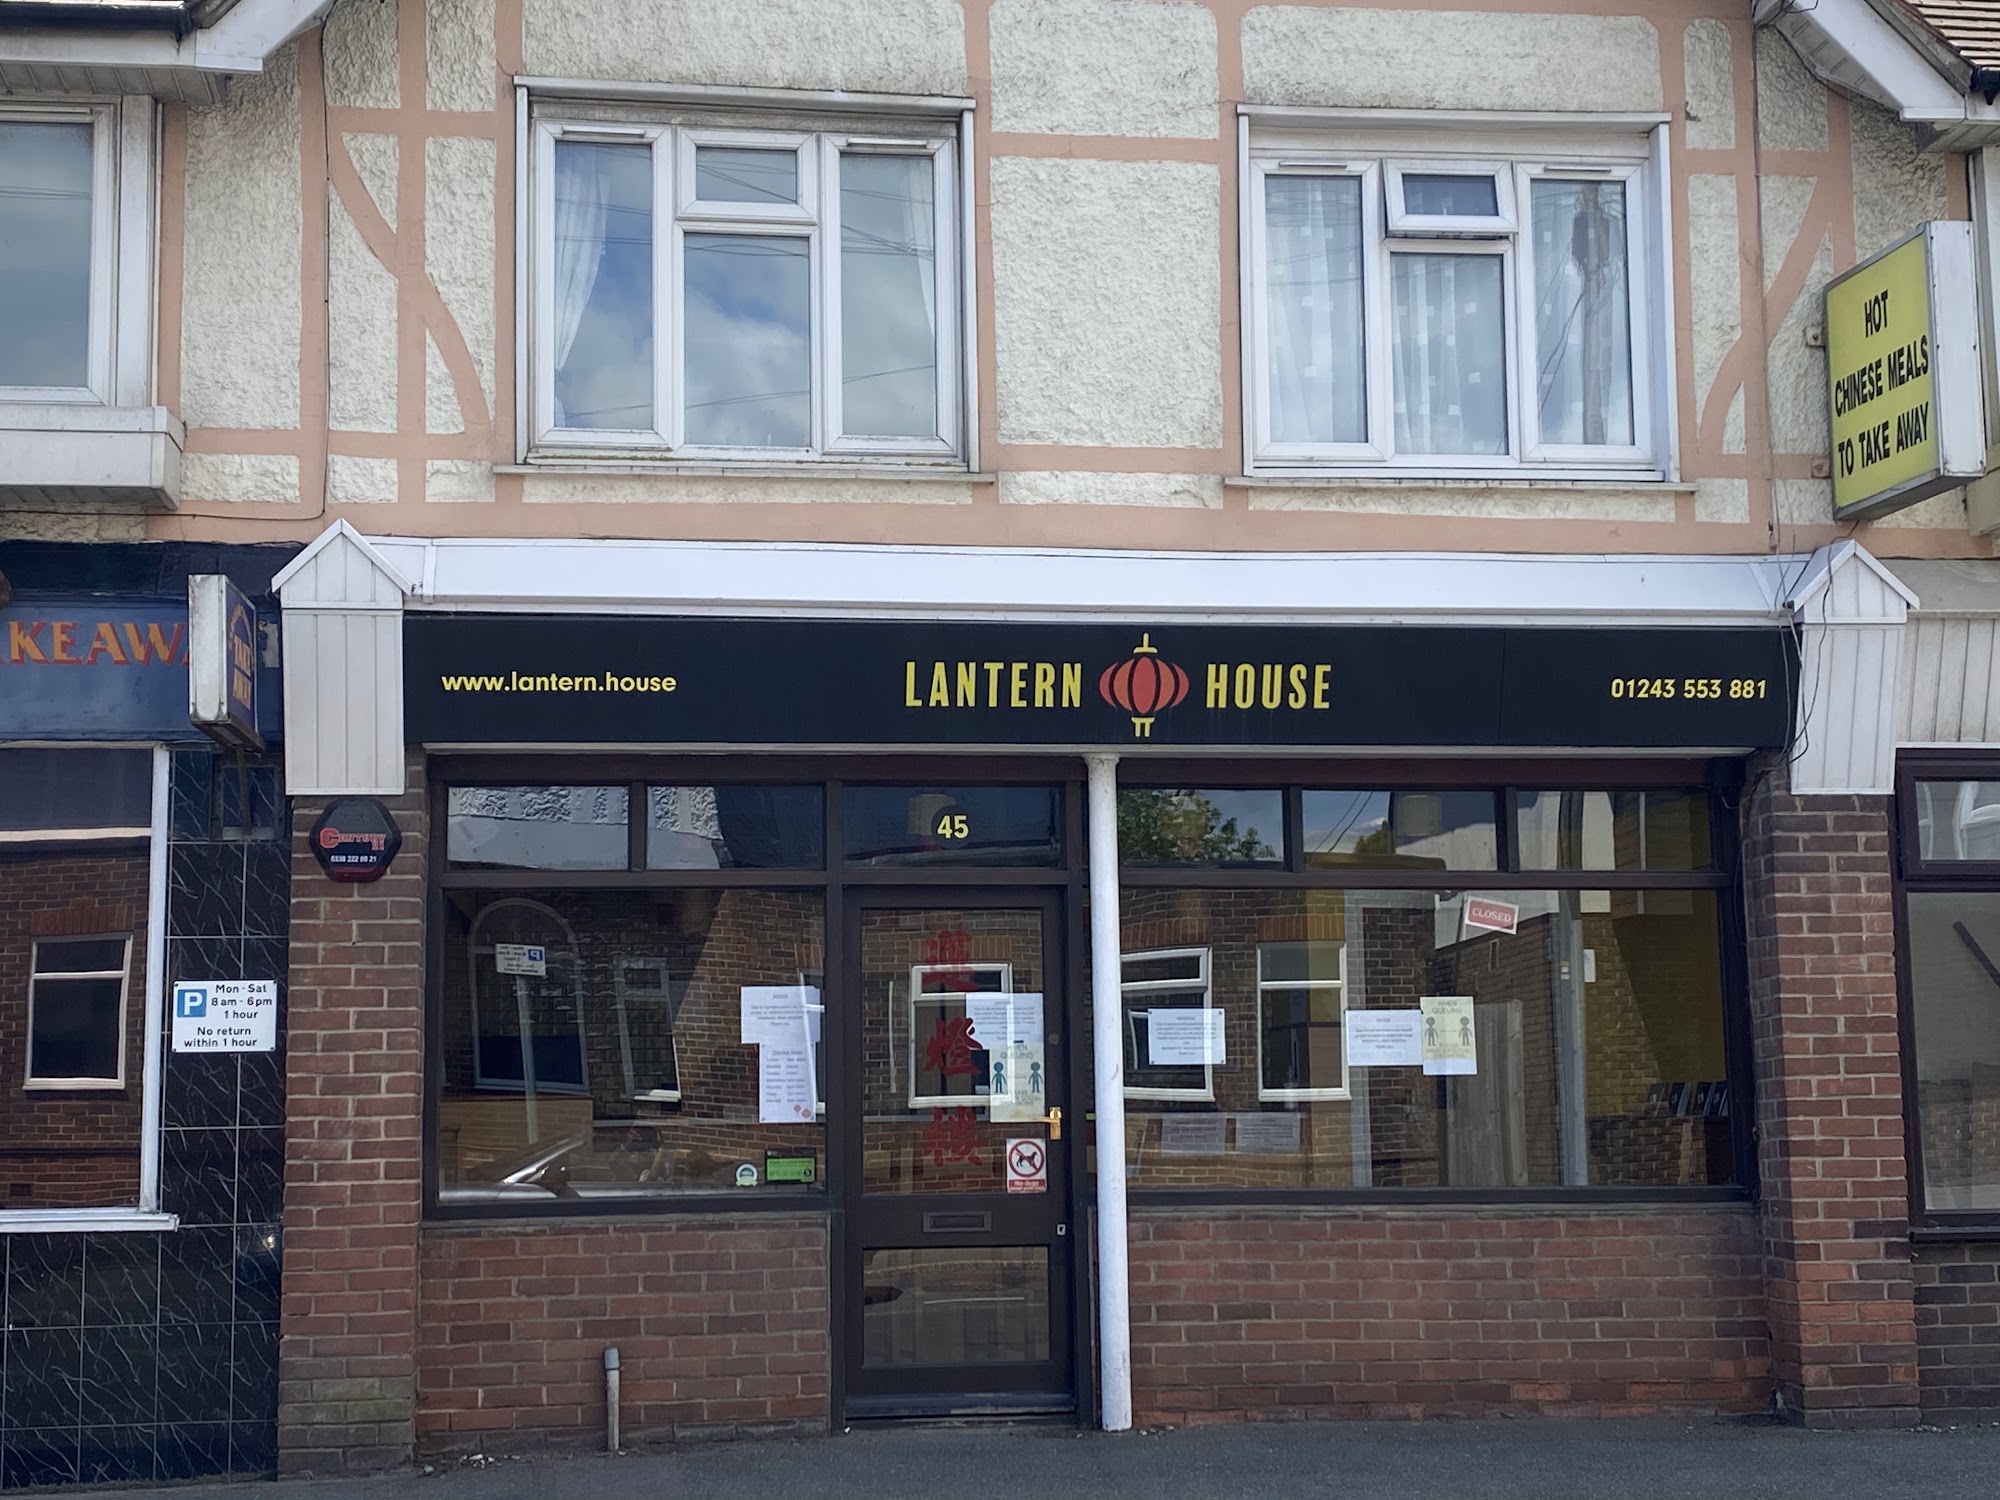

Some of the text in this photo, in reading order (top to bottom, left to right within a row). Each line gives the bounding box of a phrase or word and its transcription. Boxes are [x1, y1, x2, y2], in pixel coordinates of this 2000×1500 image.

[1864, 289, 1889, 338] HOT
[1834, 334, 1929, 417] CHINESE MEALS
[1838, 401, 1929, 478] TO TAKE AWAY
[0, 621, 189, 666] KEAW
[442, 671, 677, 692] www.lantern.house
[905, 661, 1332, 709] LANTERN HOUSE
[1611, 678, 1766, 699] 01243 553 881
[937, 815, 969, 839] 45
[1472, 907, 1511, 923] CLOSED
[215, 984, 239, 993] Mon
[248, 983, 267, 993] Sat
[184, 992, 202, 1015] P
[224, 1010, 258, 1018] 1 hour
[184, 1038, 218, 1047] within
[232, 1038, 257, 1047] hour
[197, 1027, 251, 1036] No return
